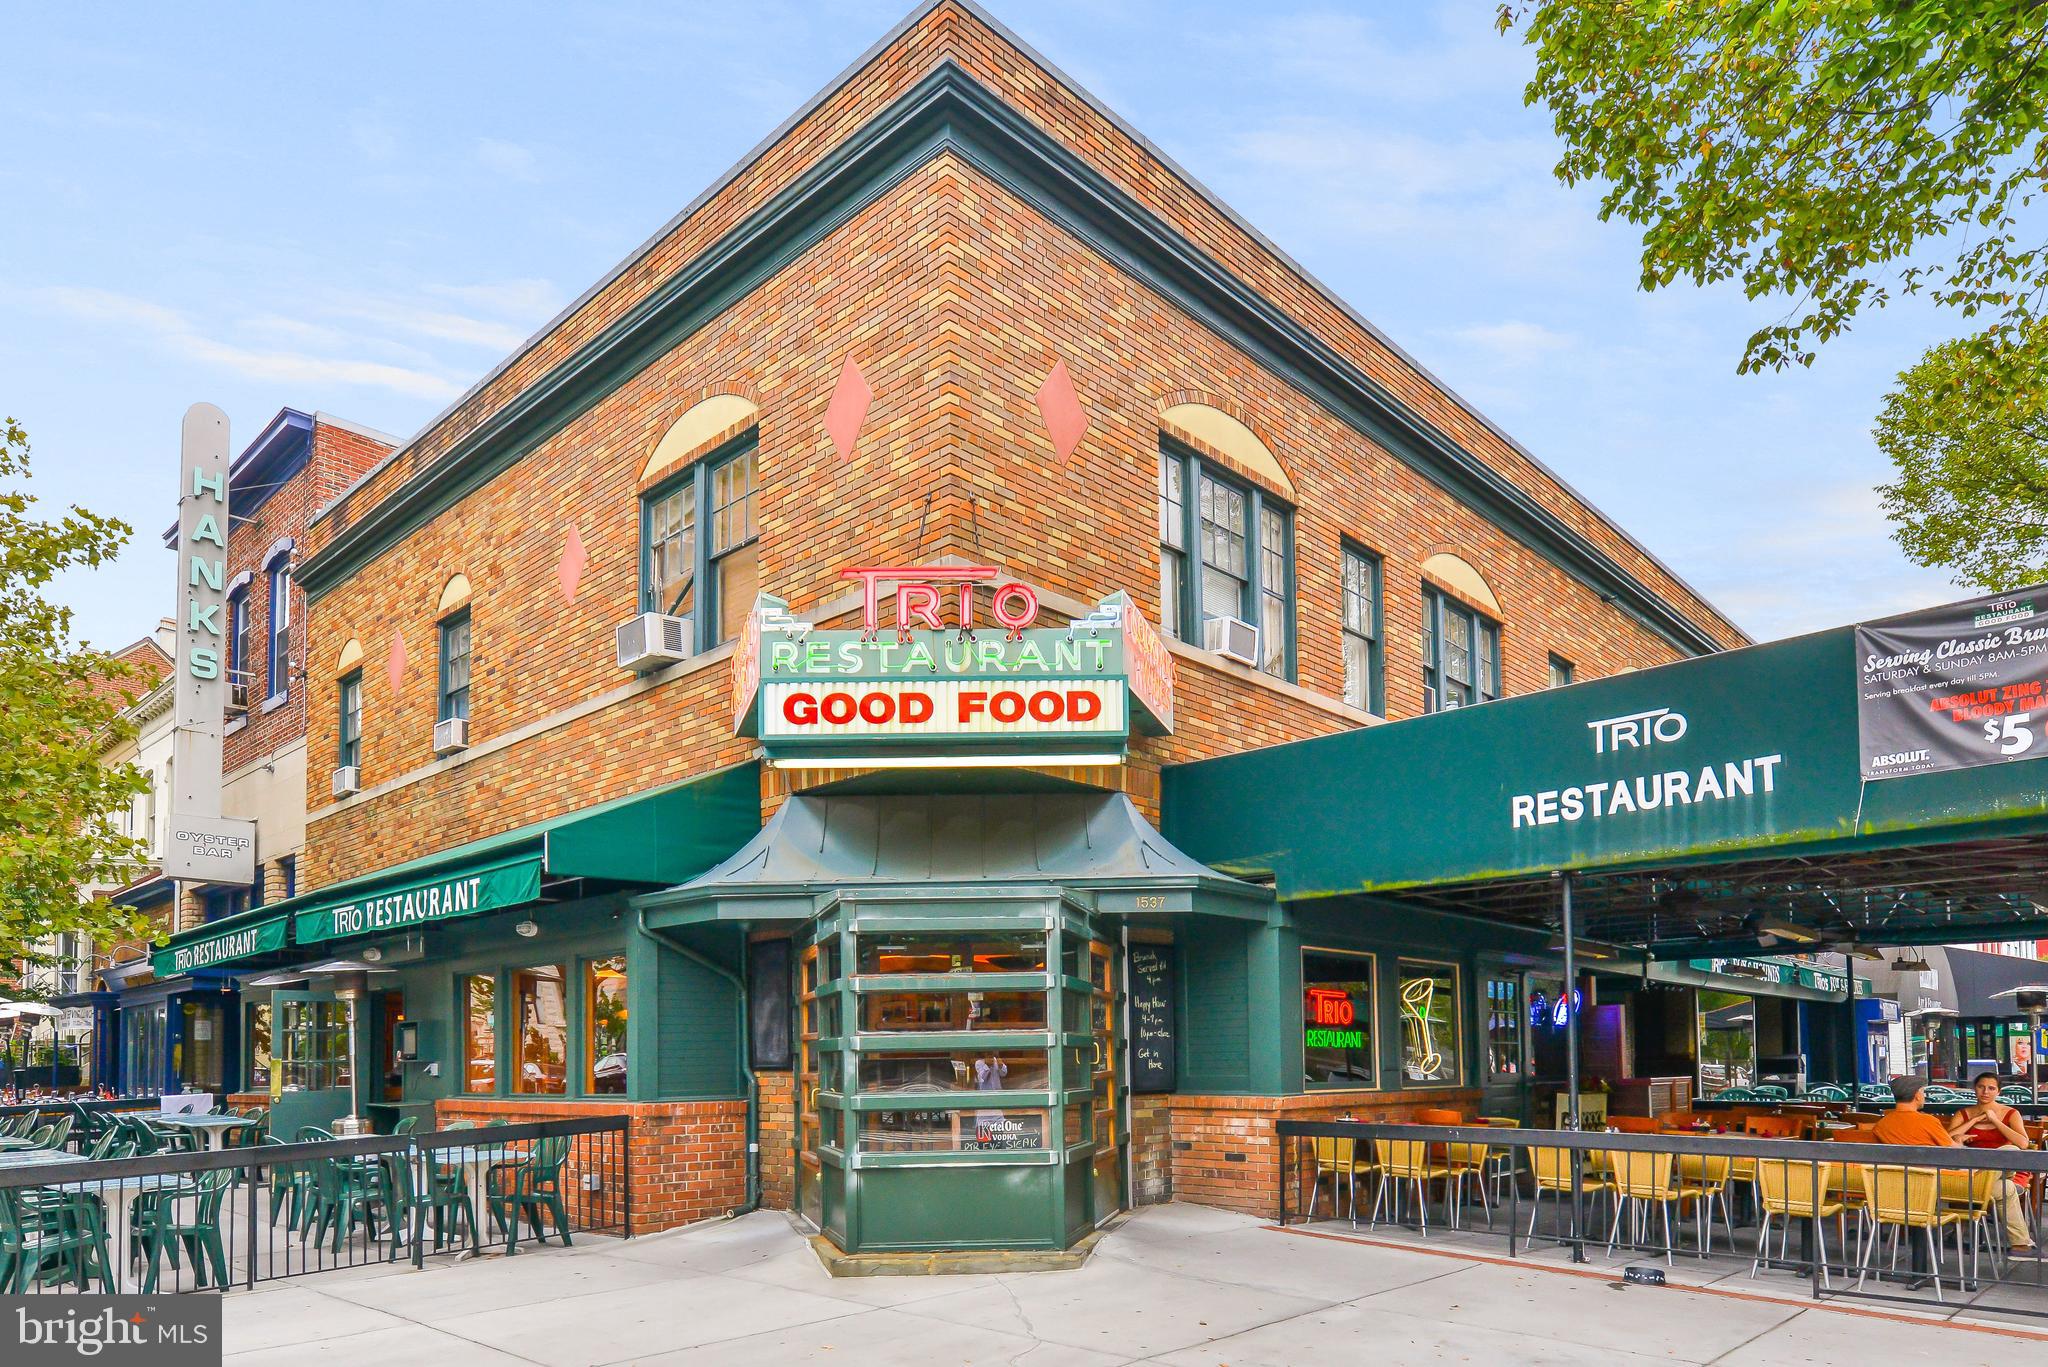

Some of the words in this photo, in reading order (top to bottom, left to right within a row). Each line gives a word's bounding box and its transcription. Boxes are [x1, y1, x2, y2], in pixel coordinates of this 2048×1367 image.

[190, 464, 225, 680] HANKS
[839, 565, 1040, 631] TRIO
[1975, 605, 2032, 621] RESTAURANT
[1987, 600, 2017, 613] TRIO
[1978, 617, 2003, 627] GOOD
[2006, 611, 2030, 621] FOOD
[771, 639, 1112, 674] RESTAURANT
[1863, 648, 1934, 673] Serving
[1936, 632, 2002, 663] Classic
[1864, 665, 1920, 685] SATURDAY
[1922, 663, 1932, 674] &
[1935, 654, 1984, 672] SUNDAY
[1988, 643, 2047, 663] 8AM-5PM
[1864, 689, 1891, 700] Serving
[1892, 683, 1927, 695] breakfast
[1929, 680, 1949, 690] every
[1950, 676, 1966, 688] day
[1967, 673, 1977, 683] till
[1978, 671, 2001, 681] 5PM.
[1929, 688, 1998, 712] ABSOLUT
[2002, 680, 2042, 700] ZING
[782, 692, 935, 726] GOOD
[958, 690, 1102, 724] FOOD
[1952, 700, 2015, 723] BLOODY
[1587, 707, 1688, 754] TRIO
[1983, 713, 2034, 756] $5
[1866, 766, 1909, 776] TRANSFORM
[1911, 763, 1936, 771] TODAY
[1512, 754, 1782, 829] RESTAURANT
[176, 831, 250, 848] OYSTER
[192, 845, 233, 859] BAR
[331, 905, 363, 935] TRIO
[366, 878, 481, 929] RESTAURANT
[1135, 896, 1167, 909] 1537
[174, 948, 193, 971] TRIO
[193, 929, 259, 967] RESTAURANT
[1310, 989, 1353, 1025] TRIO
[1138, 1048, 1150, 1058] Get
[1153, 1050, 1159, 1058] in
[1306, 1029, 1362, 1048] RESTAURANT
[992, 1133, 1018, 1141] VODKA
